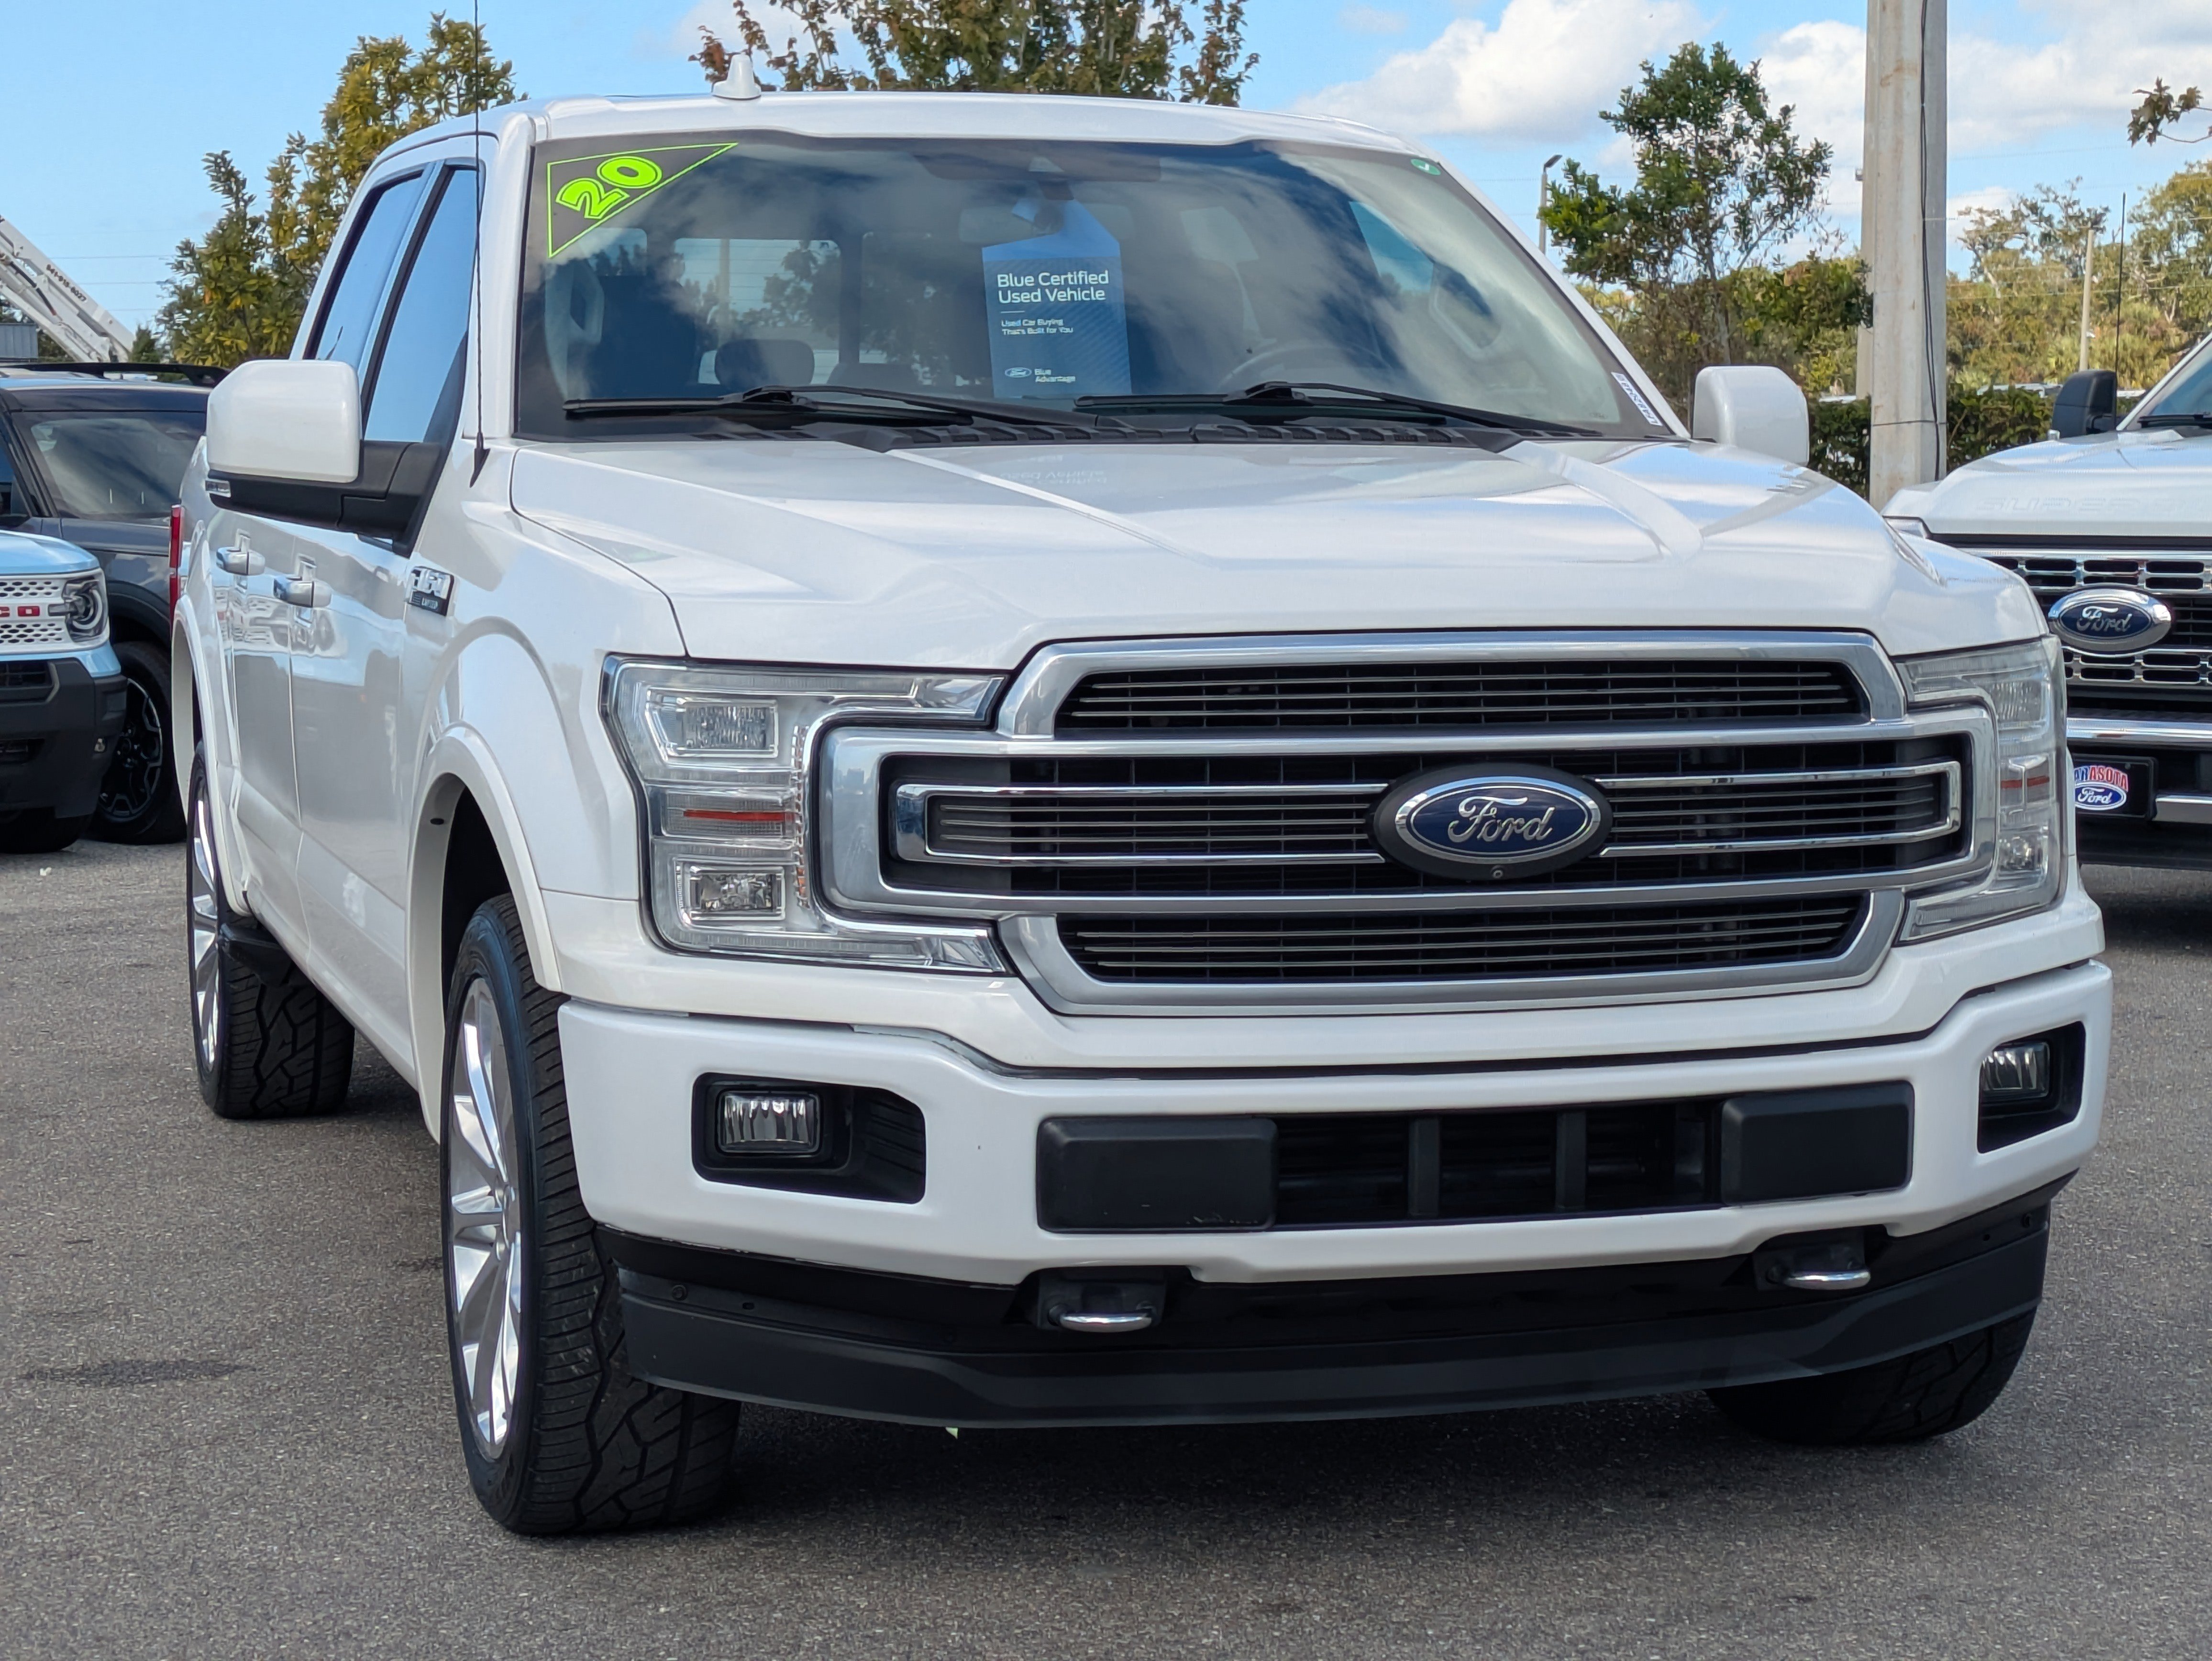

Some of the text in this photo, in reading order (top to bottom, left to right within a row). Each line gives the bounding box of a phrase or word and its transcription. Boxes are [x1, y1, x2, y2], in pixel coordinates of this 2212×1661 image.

[556, 156, 663, 219] 20
[997, 270, 1109, 287] Blue Certified
[998, 287, 1106, 304] Used Vehicle
[1037, 319, 1063, 327] Buying
[2076, 605, 2133, 632] Ford
[2074, 765, 2129, 792] ARASOTA
[2077, 787, 2113, 804] Ford
[1448, 796, 1555, 842] Ford
